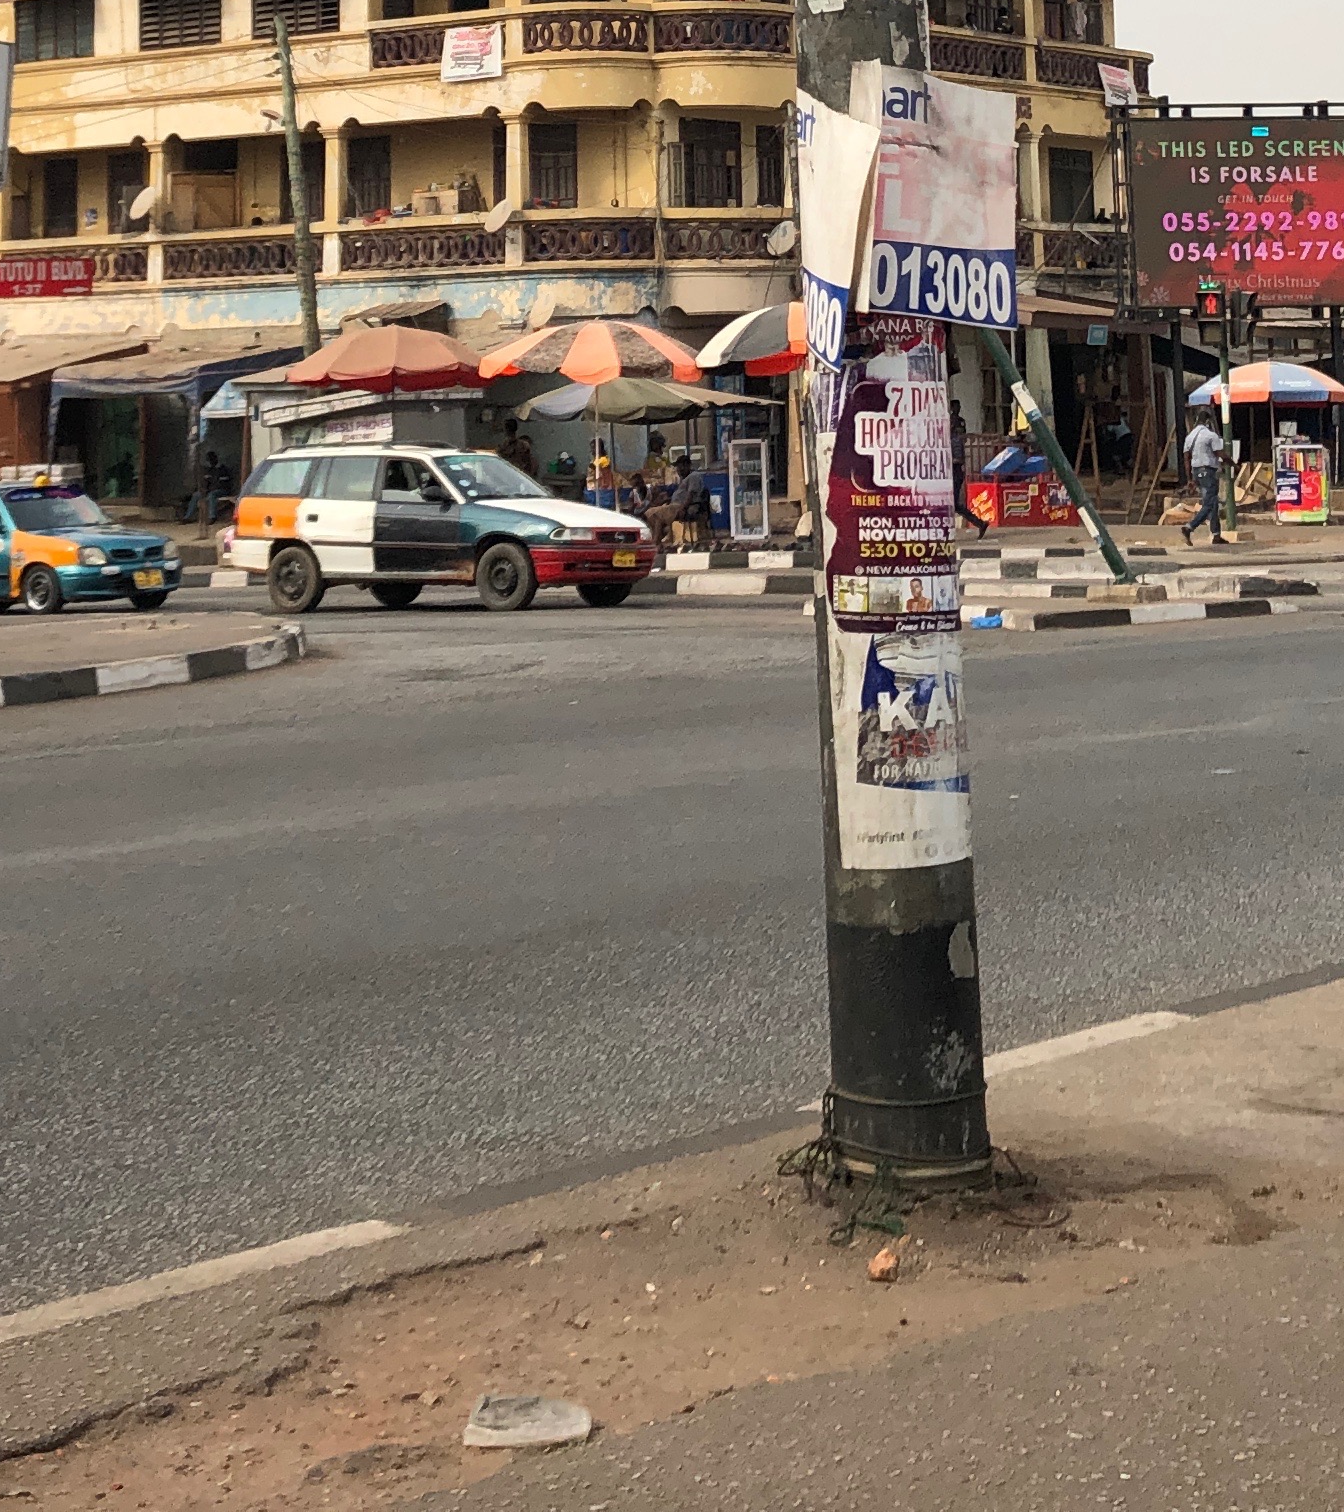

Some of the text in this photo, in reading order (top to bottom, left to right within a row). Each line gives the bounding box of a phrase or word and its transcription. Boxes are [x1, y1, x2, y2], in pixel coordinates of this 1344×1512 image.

[882, 83, 932, 125] art
[1158, 141, 1206, 158] THIS
[1216, 140, 1254, 158] LED
[1190, 166, 1318, 184] IS FORSALE
[1217, 193, 1294, 204] GET IN TOUCH
[36, 262, 46, 281] II
[51, 260, 88, 281] BLVD.
[1246, 274, 1321, 289] Christmas
[11, 284, 43, 296] 1-37
[891, 387, 903, 417] 7
[851, 494, 885, 506] THEME:
[887, 495, 911, 506] BACK
[858, 517, 895, 528] MON.
[898, 517, 925, 528] 11TH
[927, 517, 941, 527] TO
[858, 529, 946, 541] NOVEMBER,
[860, 543, 898, 558] 5:30
[902, 543, 926, 558] TO
[866, 566, 891, 575] NEW
[892, 565, 937, 575] AMAKOM
